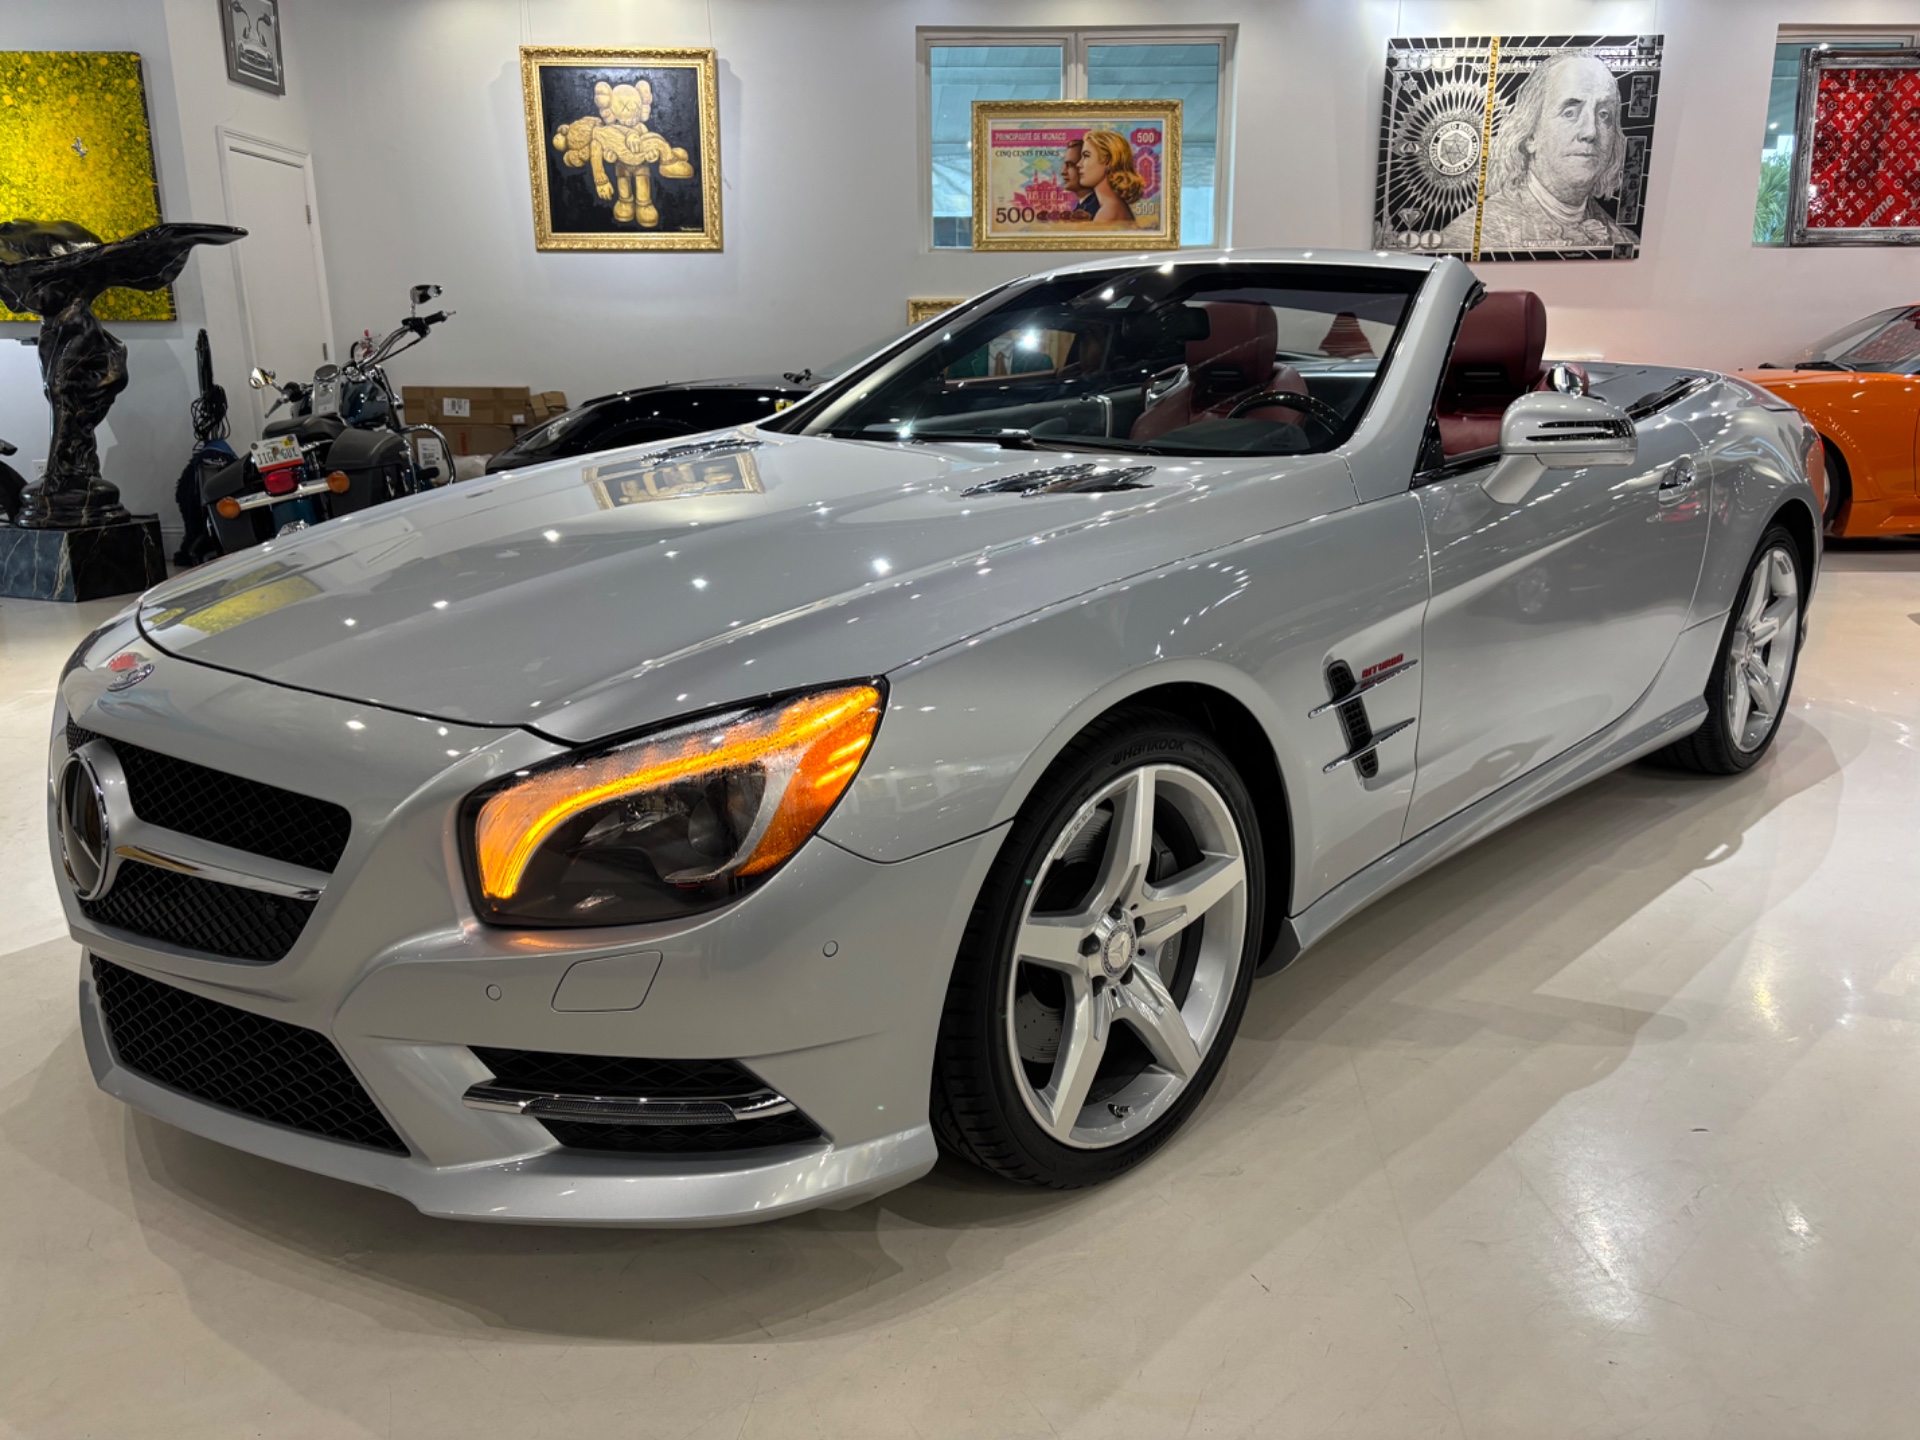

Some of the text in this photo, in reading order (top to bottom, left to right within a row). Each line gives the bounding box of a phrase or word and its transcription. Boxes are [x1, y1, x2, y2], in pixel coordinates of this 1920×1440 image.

[1042, 132, 1067, 141] MONACO
[1136, 132, 1155, 143] 500
[1135, 203, 1155, 215] 500
[995, 206, 1035, 224] 500
